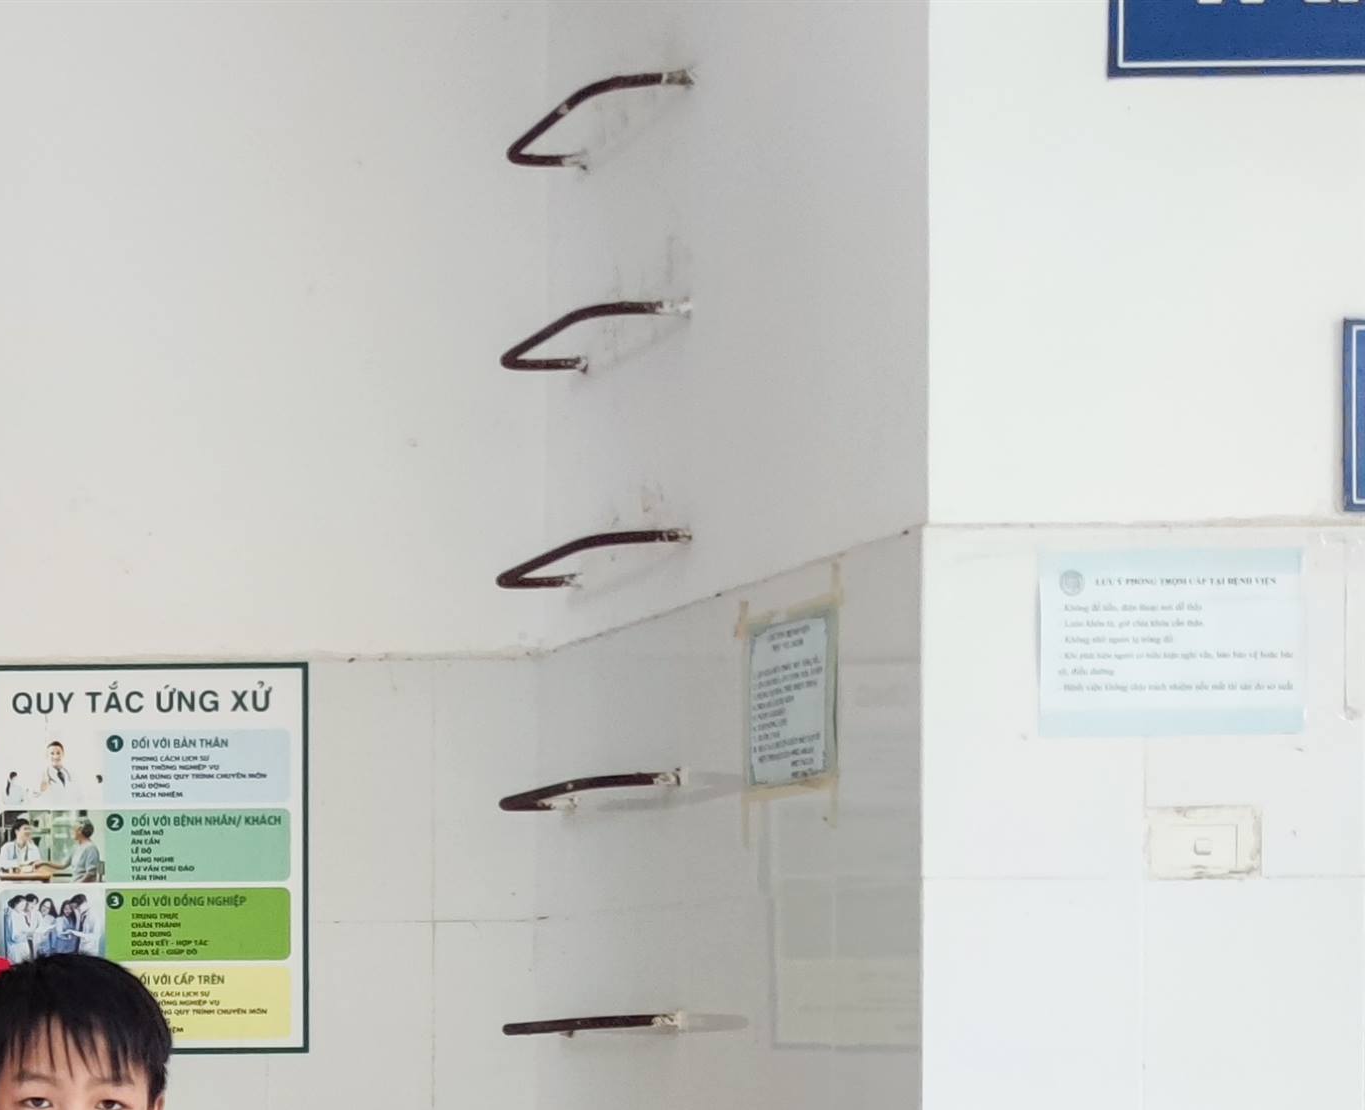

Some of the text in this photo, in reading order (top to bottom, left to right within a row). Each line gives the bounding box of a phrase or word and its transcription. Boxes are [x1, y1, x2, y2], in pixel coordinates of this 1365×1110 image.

[12, 681, 273, 715] QUY TẮC ỨNG XỬ
[110, 738, 119, 750] 1
[131, 736, 150, 749] ĐỐI
[152, 736, 171, 749] VỚI
[110, 817, 120, 828] 2
[131, 813, 150, 827] ĐỐI
[152, 814, 171, 827] VỚI
[110, 895, 120, 907] 3
[131, 893, 150, 907] ĐỐI
[152, 894, 171, 907] VỚI
[139, 972, 150, 985] ỐI
[152, 973, 171, 985] VỚI
